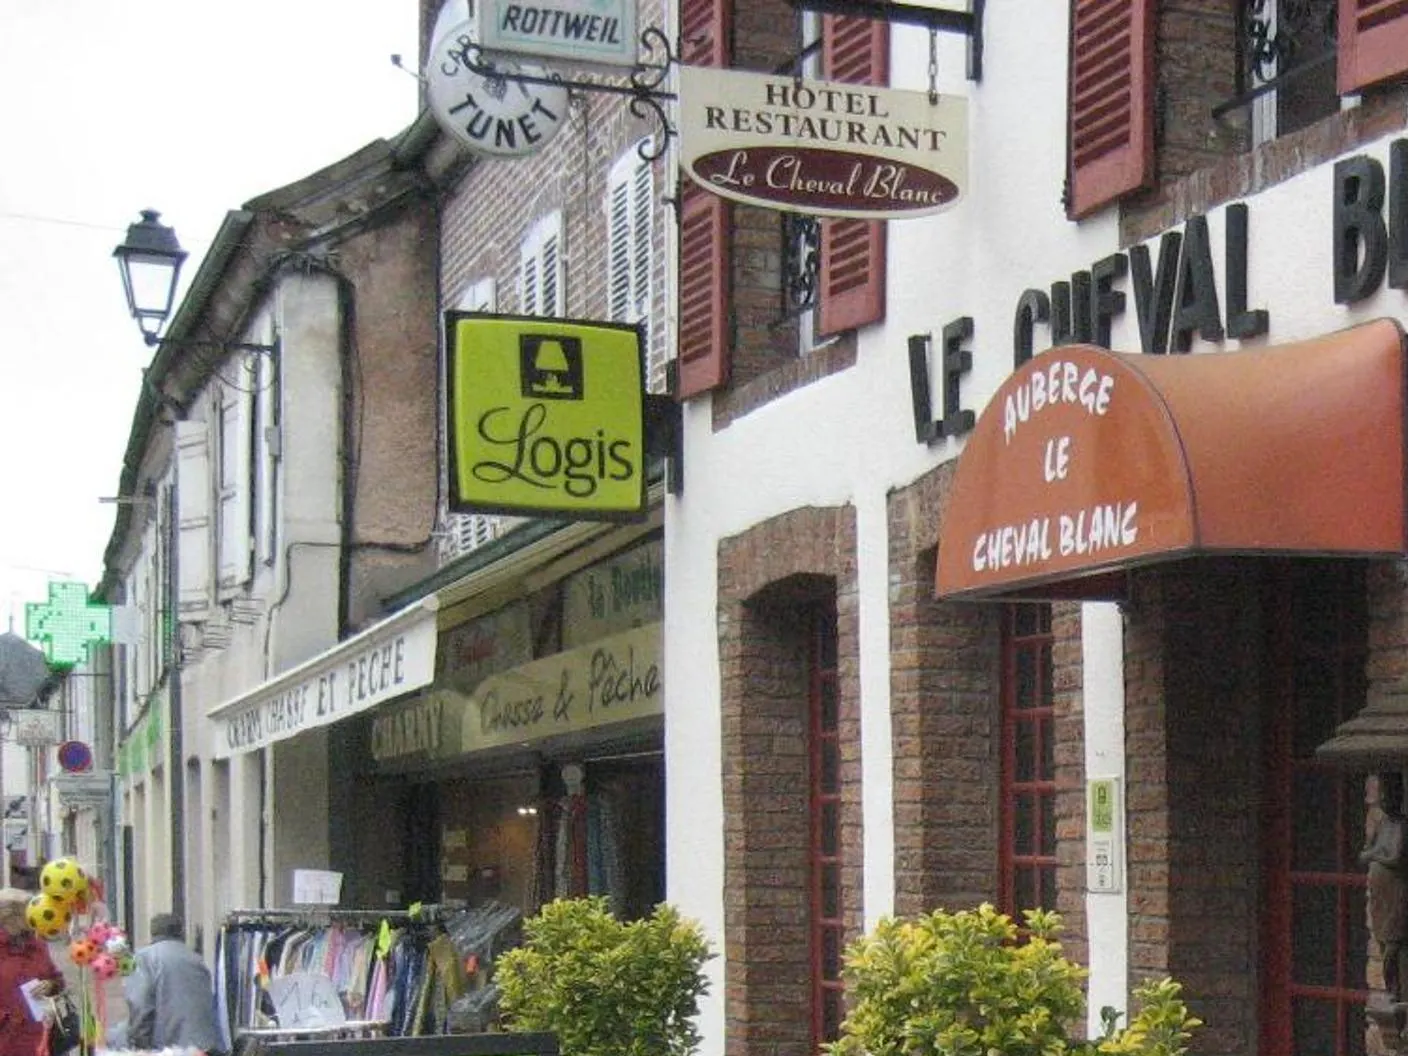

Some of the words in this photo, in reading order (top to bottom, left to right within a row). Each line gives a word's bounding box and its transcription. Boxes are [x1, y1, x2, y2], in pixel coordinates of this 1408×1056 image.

[502, 4, 620, 45] ROTTWEIL
[448, 92, 558, 148] TUNET
[704, 106, 947, 151] RESTAURANT
[709, 150, 756, 186] Le
[765, 154, 863, 197] Cheval
[862, 164, 943, 204] Blanc
[907, 314, 976, 444] LE
[1003, 361, 1114, 447] AUBERGE
[472, 402, 634, 499] Logis
[1044, 435, 1070, 482] LE
[972, 517, 1052, 572] CHEVAL
[1059, 502, 1139, 556] BLANC
